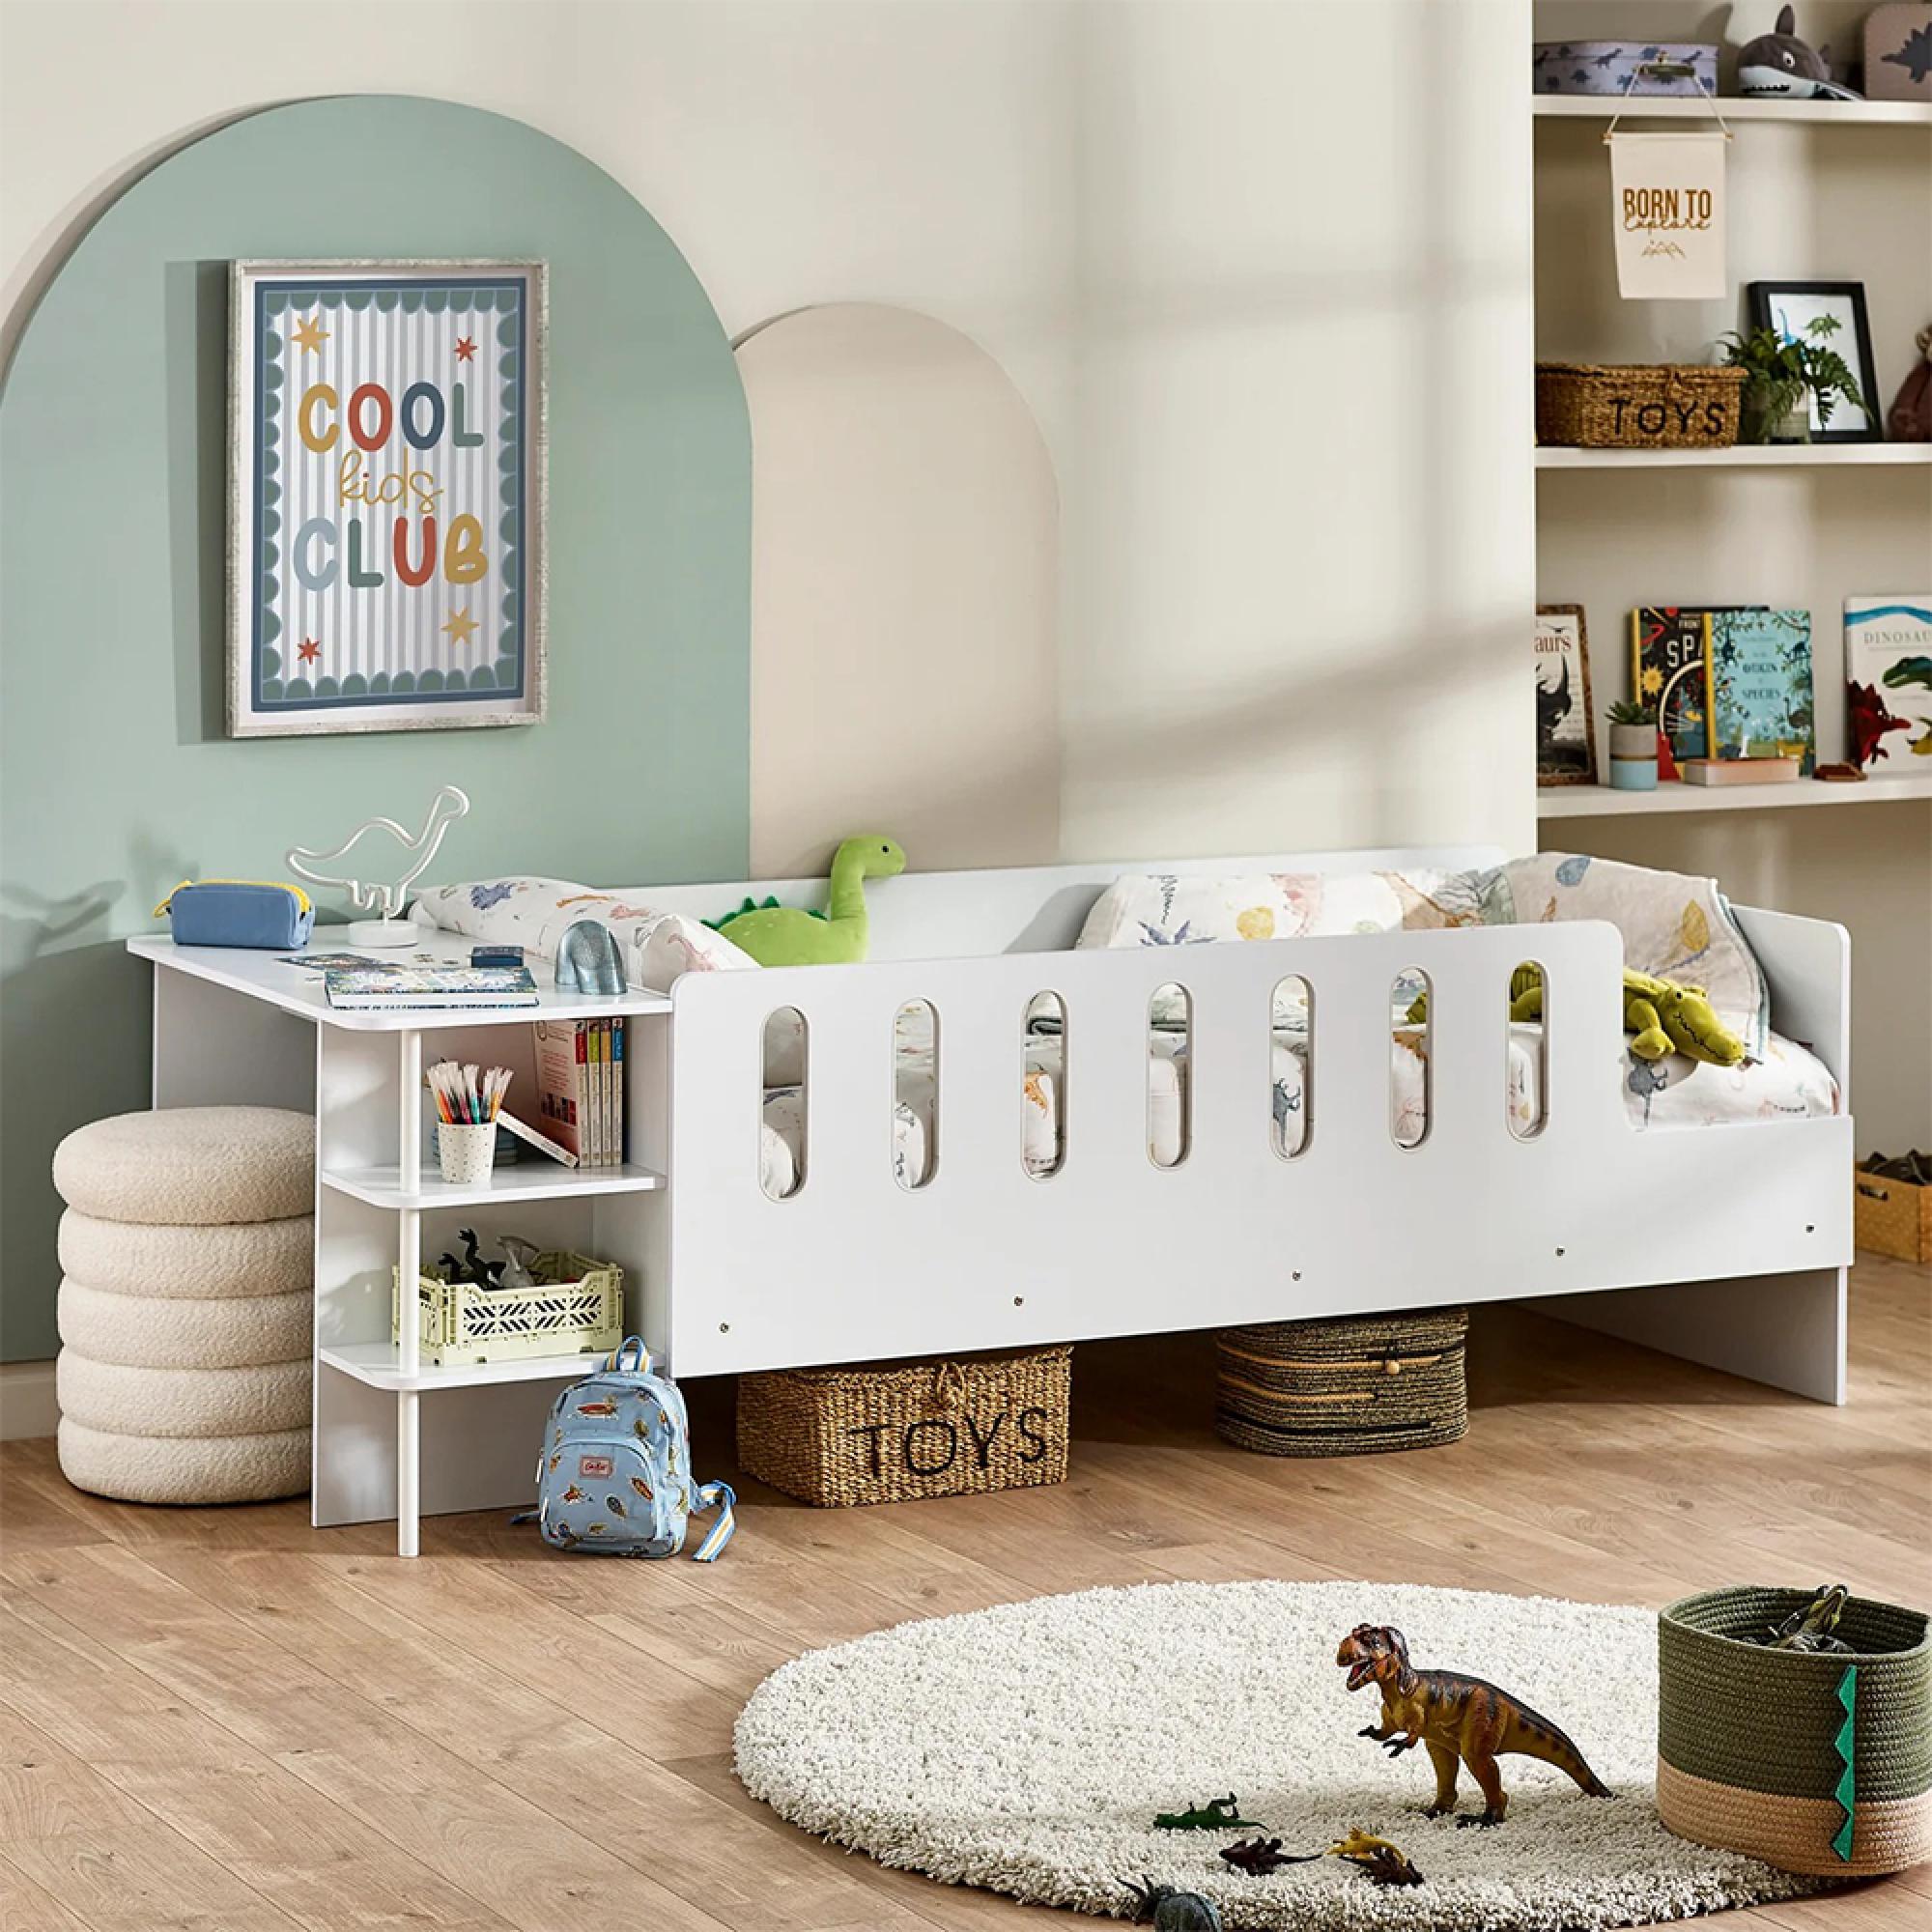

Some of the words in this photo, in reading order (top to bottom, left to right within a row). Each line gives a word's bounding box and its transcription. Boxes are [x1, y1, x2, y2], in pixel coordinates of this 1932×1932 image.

[1624, 187, 1679, 219] BORN
[1684, 188, 1712, 219] TO
[298, 382, 486, 453] COOL
[1607, 397, 1726, 436] TOYS
[338, 445, 444, 515] kids
[293, 513, 489, 592] CLUB
[846, 1406, 1049, 1479] TOYS
